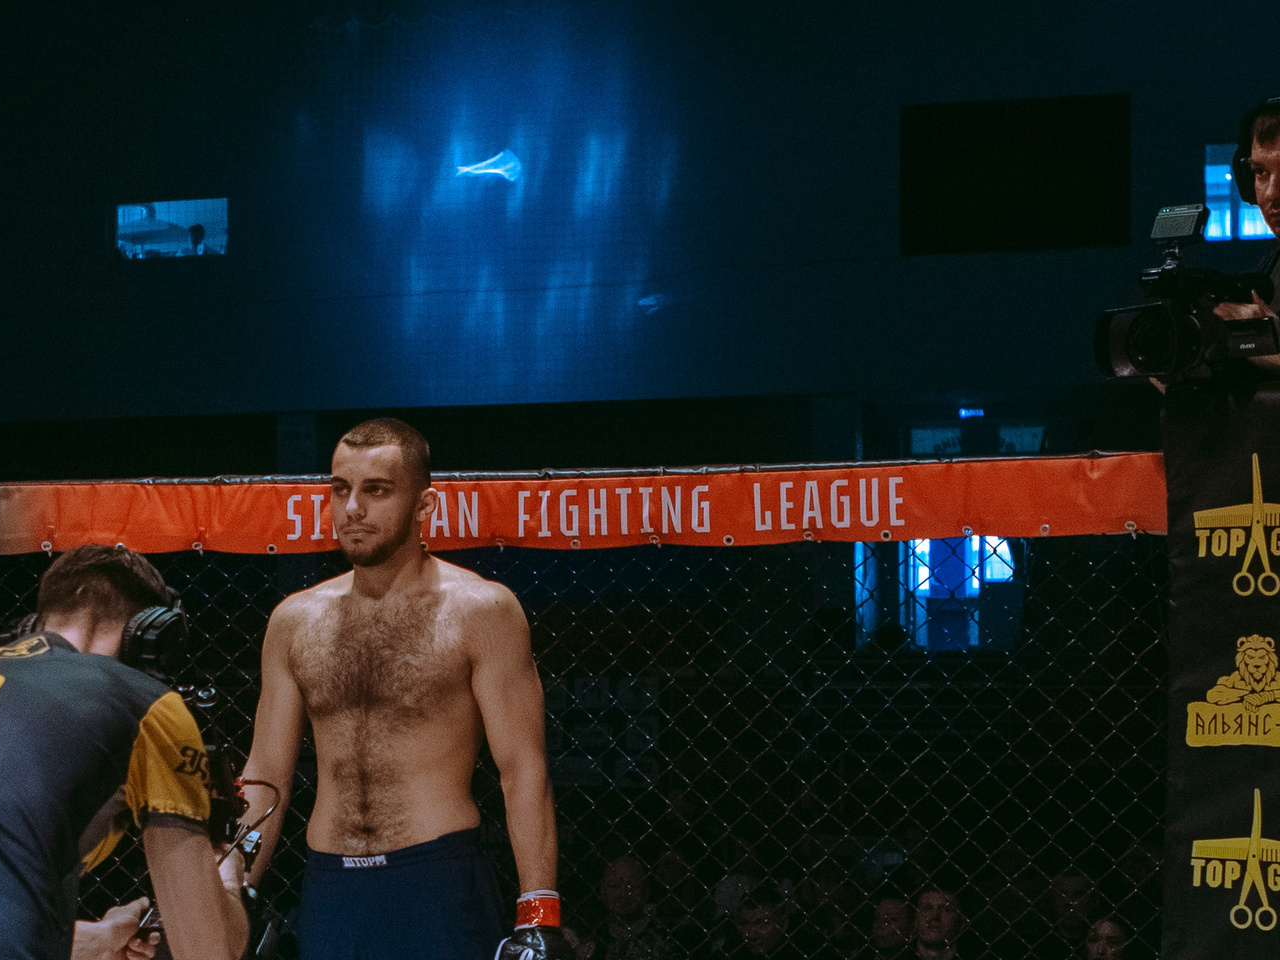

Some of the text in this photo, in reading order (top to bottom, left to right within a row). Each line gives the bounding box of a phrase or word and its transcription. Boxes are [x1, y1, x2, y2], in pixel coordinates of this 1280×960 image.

[286, 476, 906, 541] SIAN FIGHTING LEAGUE
[1195, 528, 1246, 557] TOP
[342, 854, 387, 869] ШТОРМ
[1191, 858, 1241, 889] TOP
